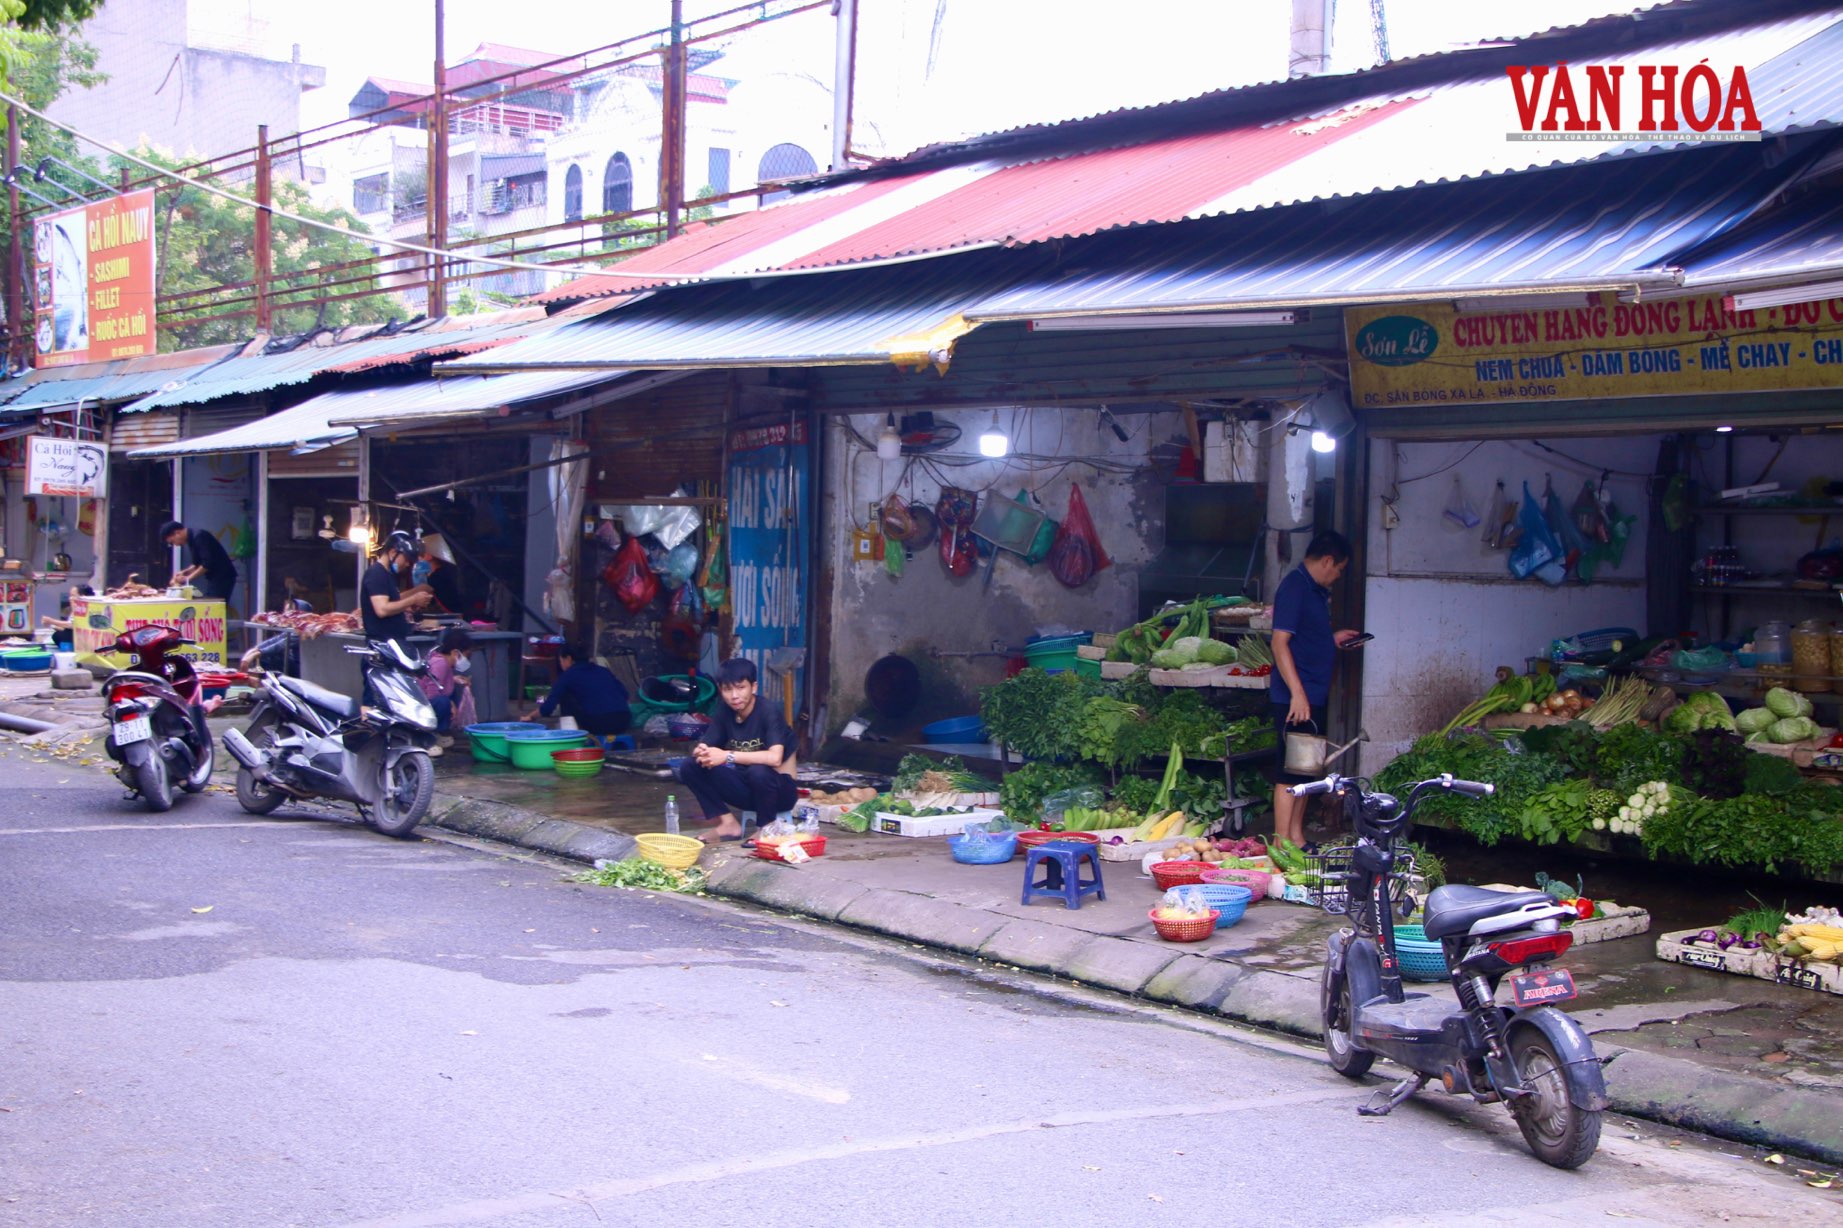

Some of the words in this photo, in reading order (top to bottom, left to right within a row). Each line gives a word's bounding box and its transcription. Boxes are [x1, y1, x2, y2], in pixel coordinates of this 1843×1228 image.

[89, 211, 103, 252] CÁ
[121, 207, 150, 245] NAUY
[95, 256, 130, 284] SASHIMI
[95, 287, 120, 310] FILLET
[118, 312, 131, 338] CÁ
[1475, 358, 1514, 382] NEM
[1737, 341, 1791, 369] CHAY
[1519, 382, 1557, 397] ĐÔNG
[198, 606, 224, 644] SỐNG
[201, 652, 221, 663] 228
[1523, 984, 1569, 1000] ARENA
